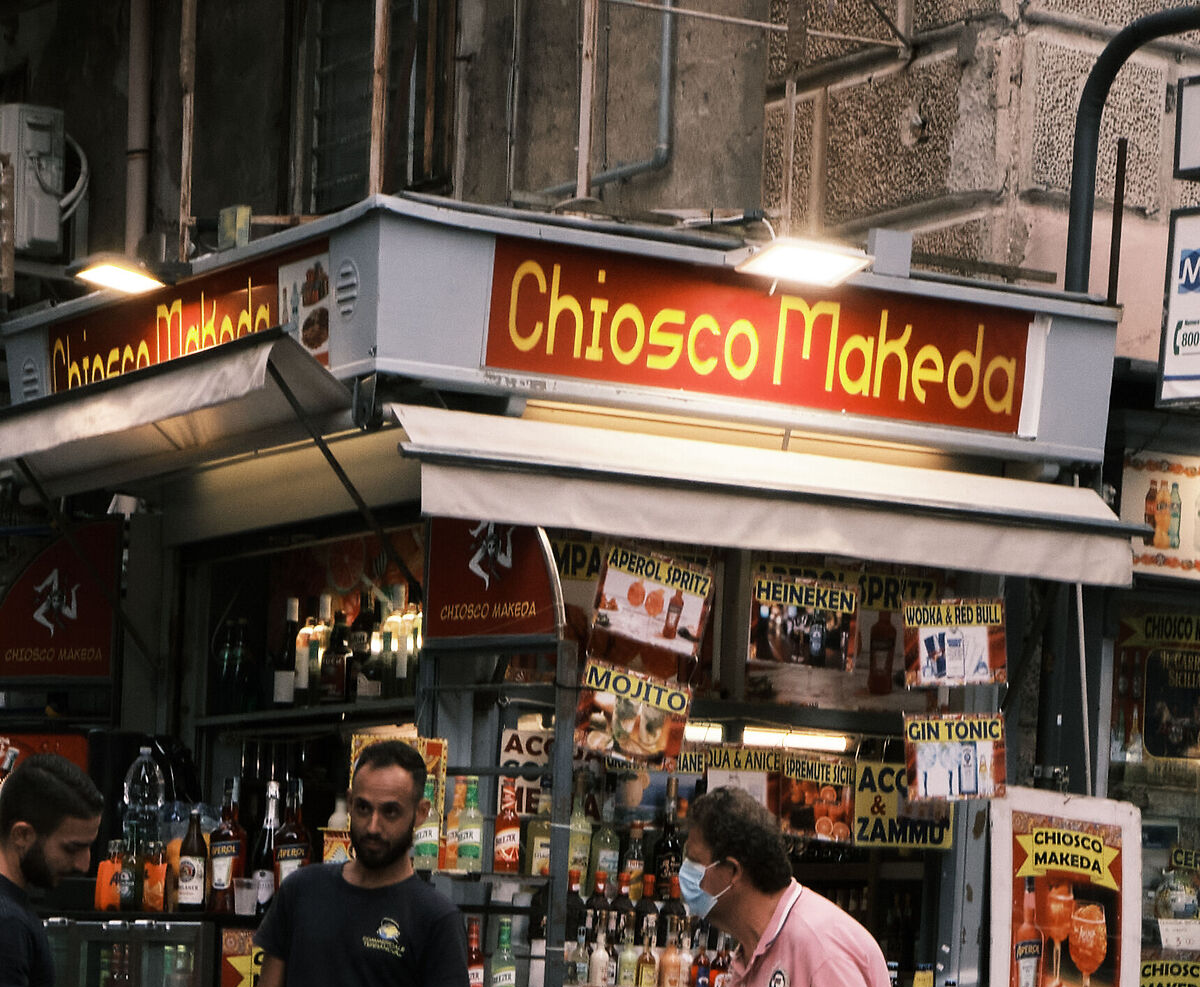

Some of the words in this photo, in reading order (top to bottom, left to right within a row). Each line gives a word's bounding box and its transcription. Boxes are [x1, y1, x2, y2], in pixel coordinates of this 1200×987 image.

[508, 259, 759, 381] Chiosco
[773, 297, 1017, 414] Makeda
[609, 551, 661, 580] APEROL
[665, 567, 709, 596] SPRITZ
[756, 580, 854, 612] HEINEKEN
[440, 603, 490, 620] CHIOSCO
[492, 600, 536, 618] MAKEDA
[906, 606, 942, 625] WODKA
[955, 606, 973, 624] RED
[977, 604, 1000, 624] BULL
[4, 648, 55, 662] CHIOSCO
[587, 665, 687, 712] MOJITO
[908, 722, 940, 741] GIN
[945, 721, 1000, 739] TONIC
[744, 750, 781, 772] ANICE
[785, 758, 831, 782] SPREMUTE
[870, 795, 886, 816] &
[1034, 831, 1104, 854] CHIOSCO
[1034, 852, 1103, 875] MAKEDA
